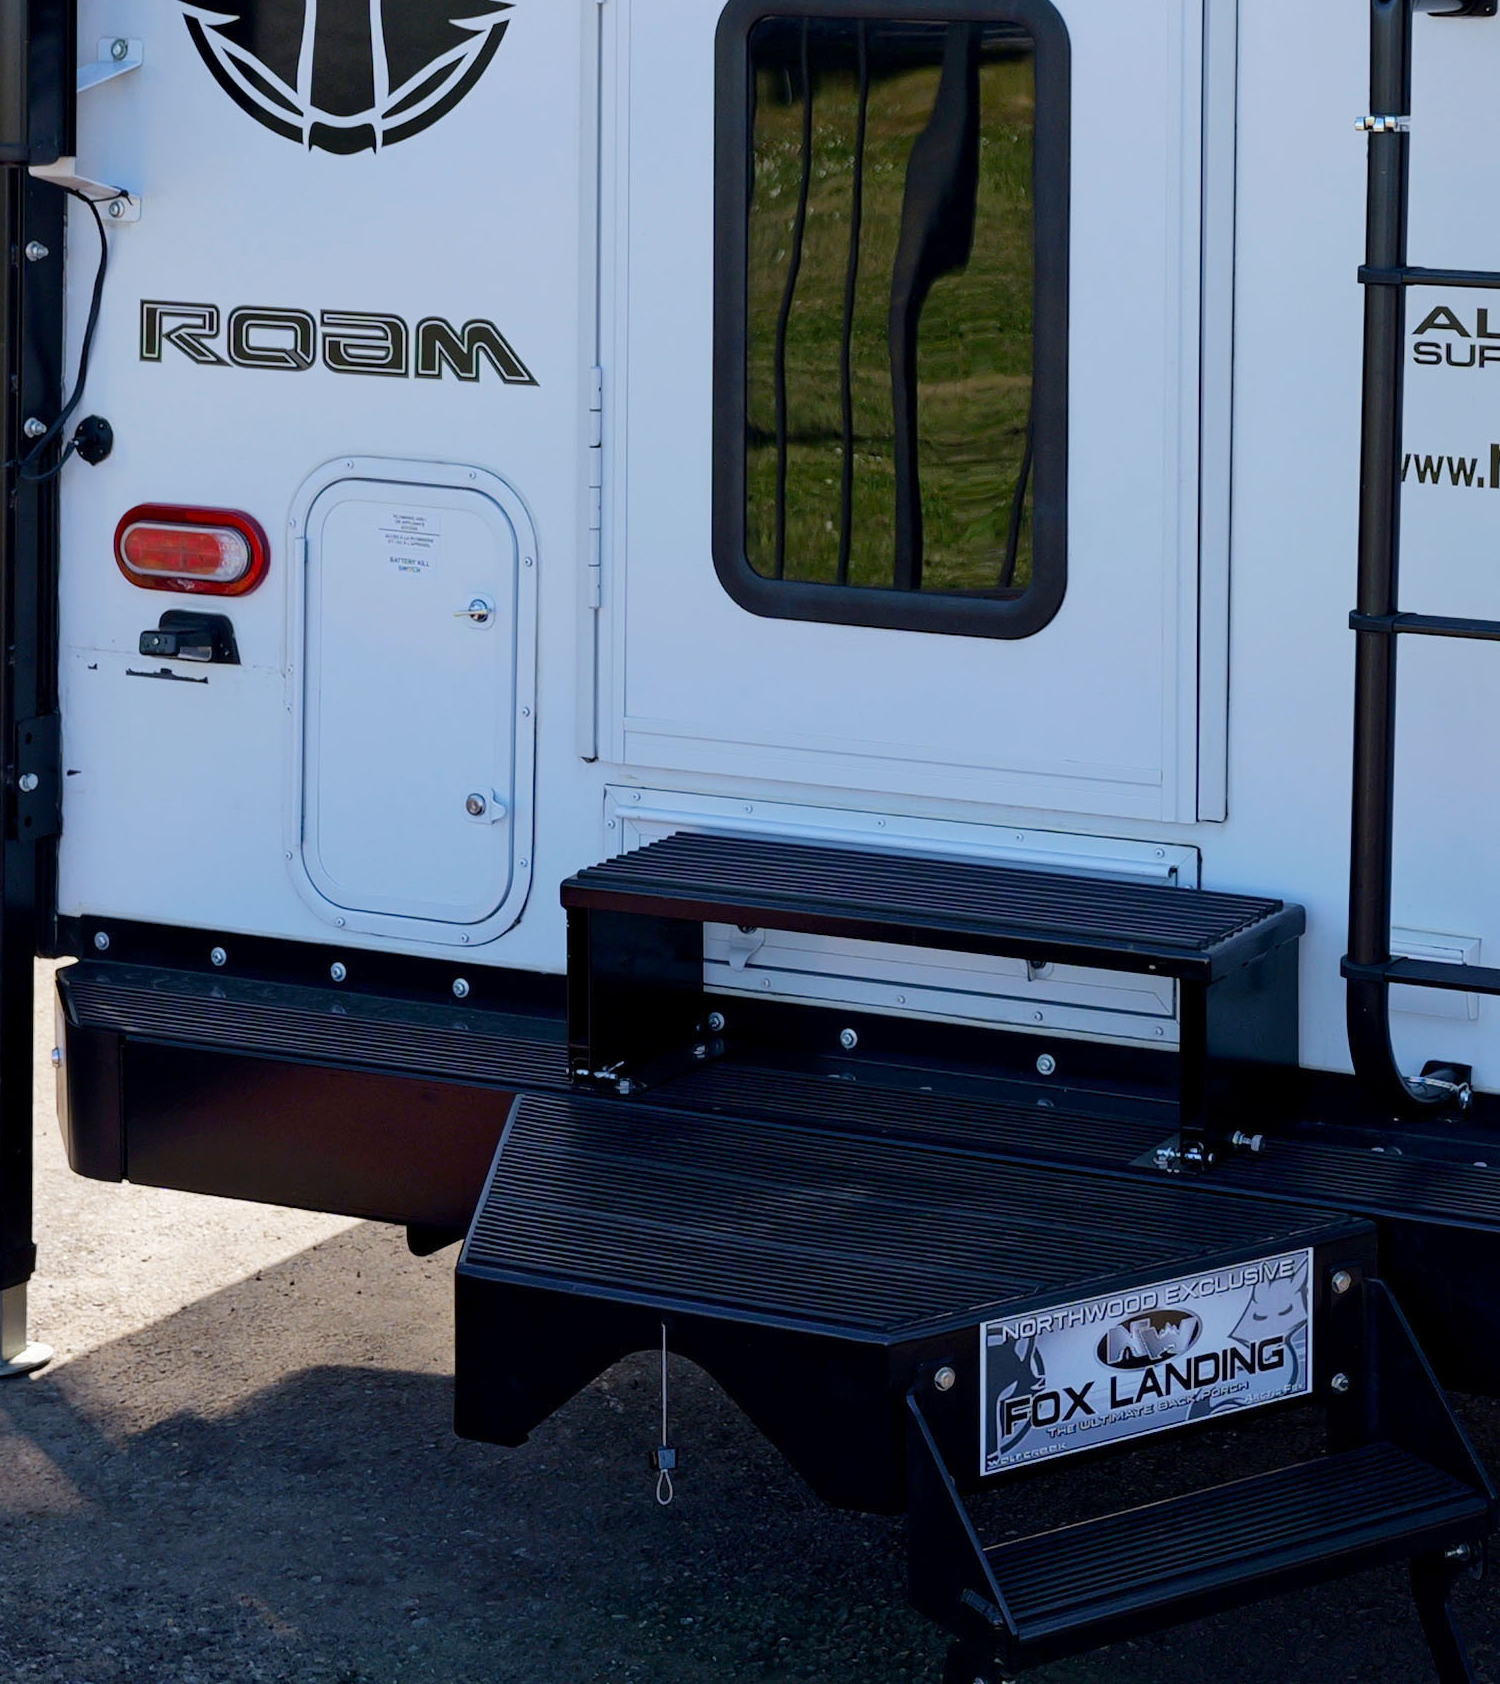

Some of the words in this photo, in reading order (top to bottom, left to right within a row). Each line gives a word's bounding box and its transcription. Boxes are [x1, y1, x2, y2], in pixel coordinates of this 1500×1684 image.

[1000, 1290, 1160, 1344] NORTHWOOD
[1166, 1259, 1297, 1306] EXCLUSIVE
[1003, 1380, 1096, 1436] FOX
[1110, 1335, 1285, 1410] LANDING
[1046, 1423, 1077, 1439] THE
[1079, 1404, 1155, 1432] ULTIMATE
[1157, 1394, 1197, 1414] BACK
[1200, 1381, 1250, 1401] PORCH
